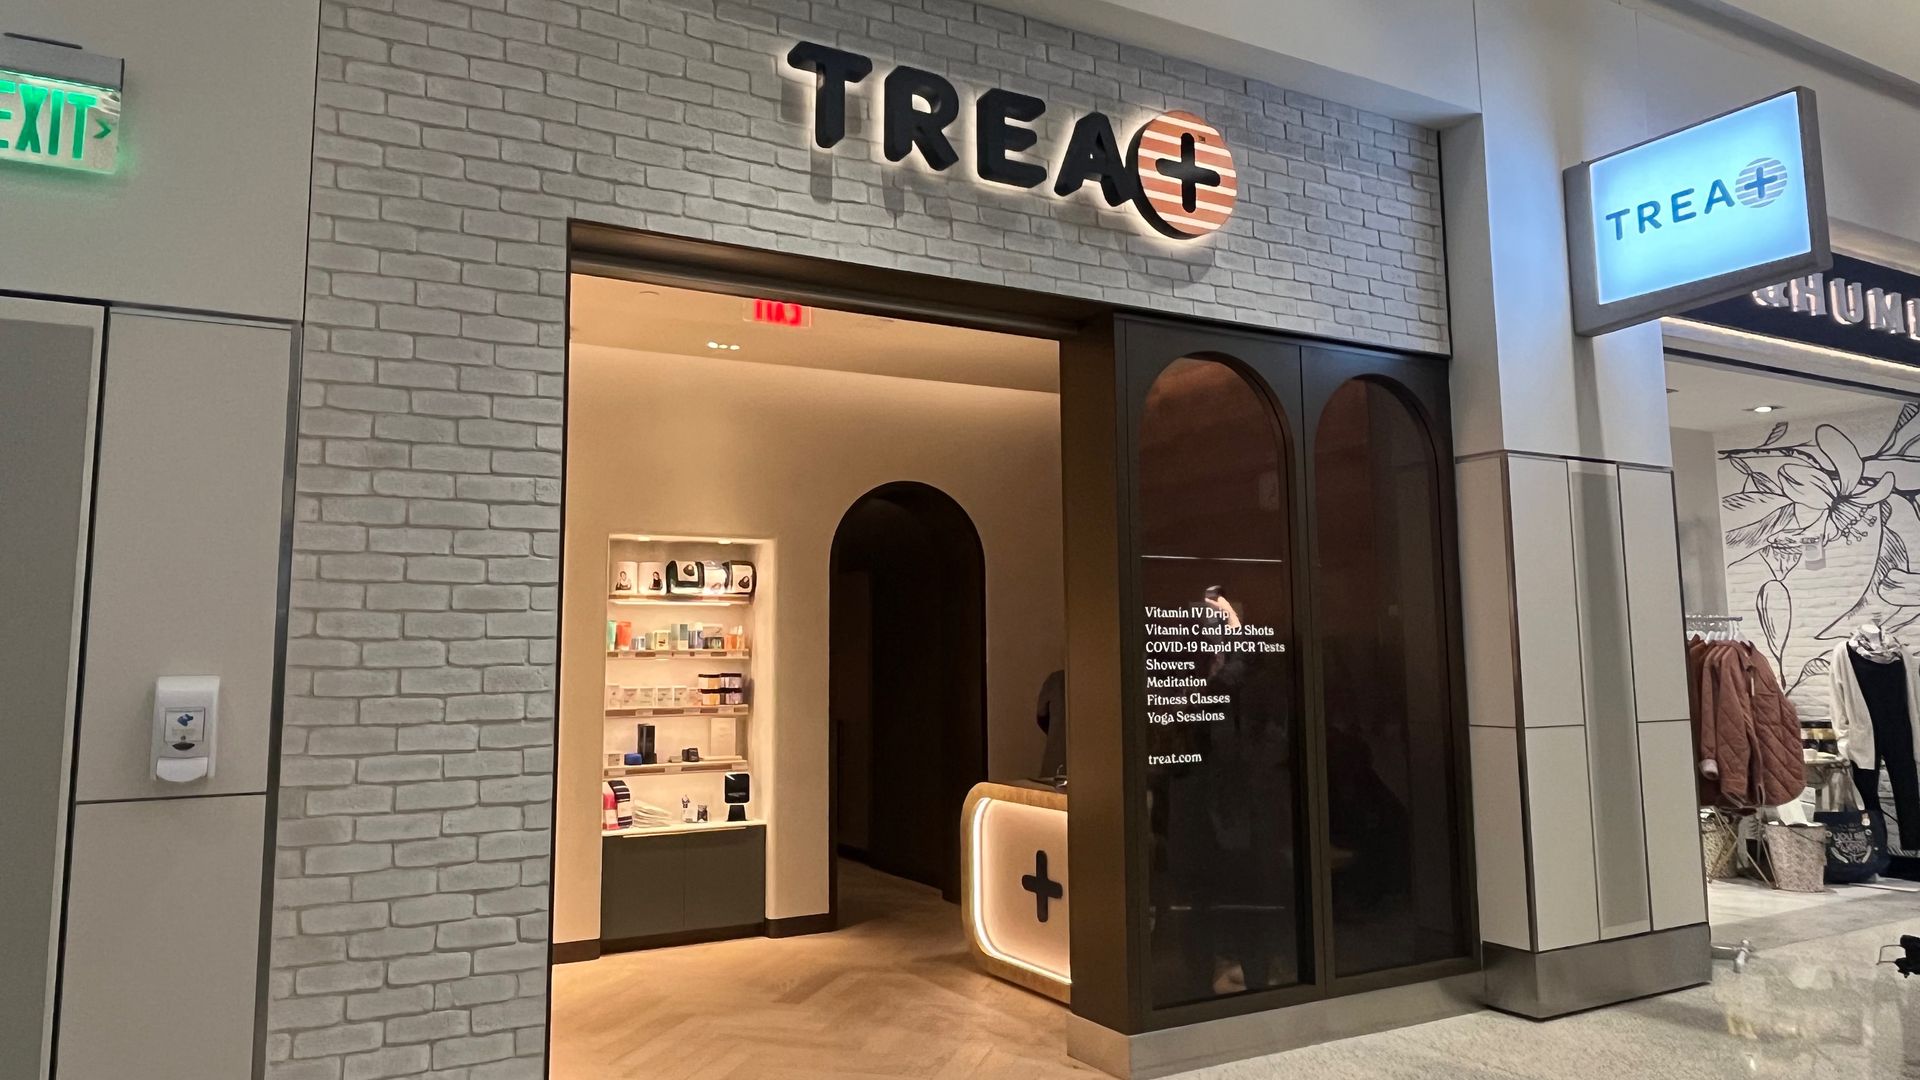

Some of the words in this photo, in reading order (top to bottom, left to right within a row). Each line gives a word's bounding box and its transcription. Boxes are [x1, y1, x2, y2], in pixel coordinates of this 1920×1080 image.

[0, 79, 97, 160] EXIT
[1145, 607, 1188, 618] Vitamin
[1192, 608, 1203, 618] IV
[1145, 624, 1189, 635] Vitamin
[1192, 624, 1199, 635] C
[1202, 625, 1221, 635] and
[1224, 625, 1242, 635] B12
[1244, 625, 1274, 635] Shots
[1145, 642, 1198, 652] COVID-19
[1200, 642, 1231, 654] Rapid
[1234, 642, 1255, 652] PCR
[1257, 642, 1285, 652] Tests
[1146, 659, 1195, 670] Showers
[1147, 676, 1207, 688] Meditation
[1147, 695, 1187, 705] Fitness
[1190, 693, 1230, 704] Classes
[1148, 712, 1174, 725] Yoga
[1176, 710, 1225, 722] Sessions
[1148, 753, 1202, 764] treat.com
